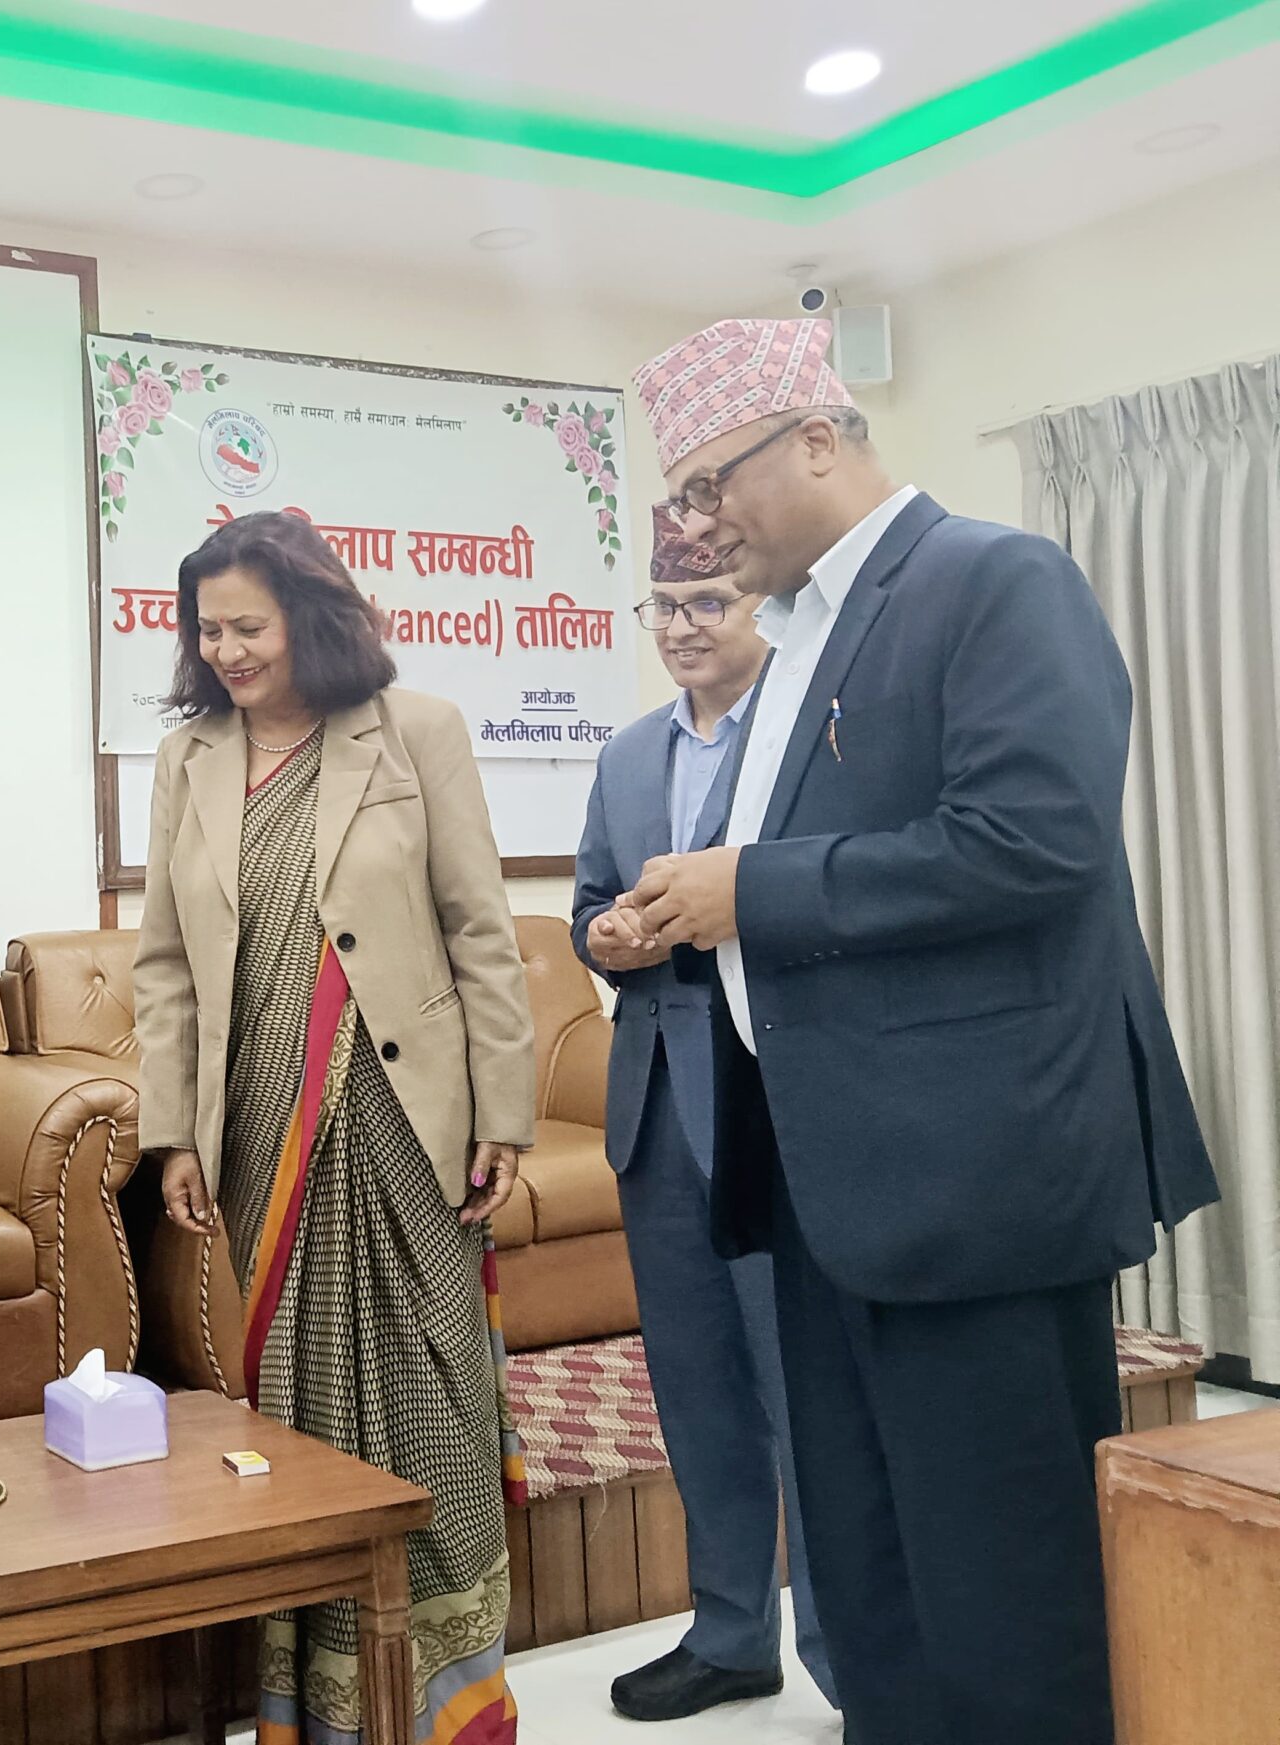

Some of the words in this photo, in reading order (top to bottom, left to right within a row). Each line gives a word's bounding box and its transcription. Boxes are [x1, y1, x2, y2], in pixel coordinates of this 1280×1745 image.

[407, 524, 534, 579] सम्बन्धी
[370, 593, 503, 656] vanced)
[515, 592, 614, 650] तालिम
[521, 687, 576, 705] आयोजक
[480, 719, 562, 742] मेलमिलाप
